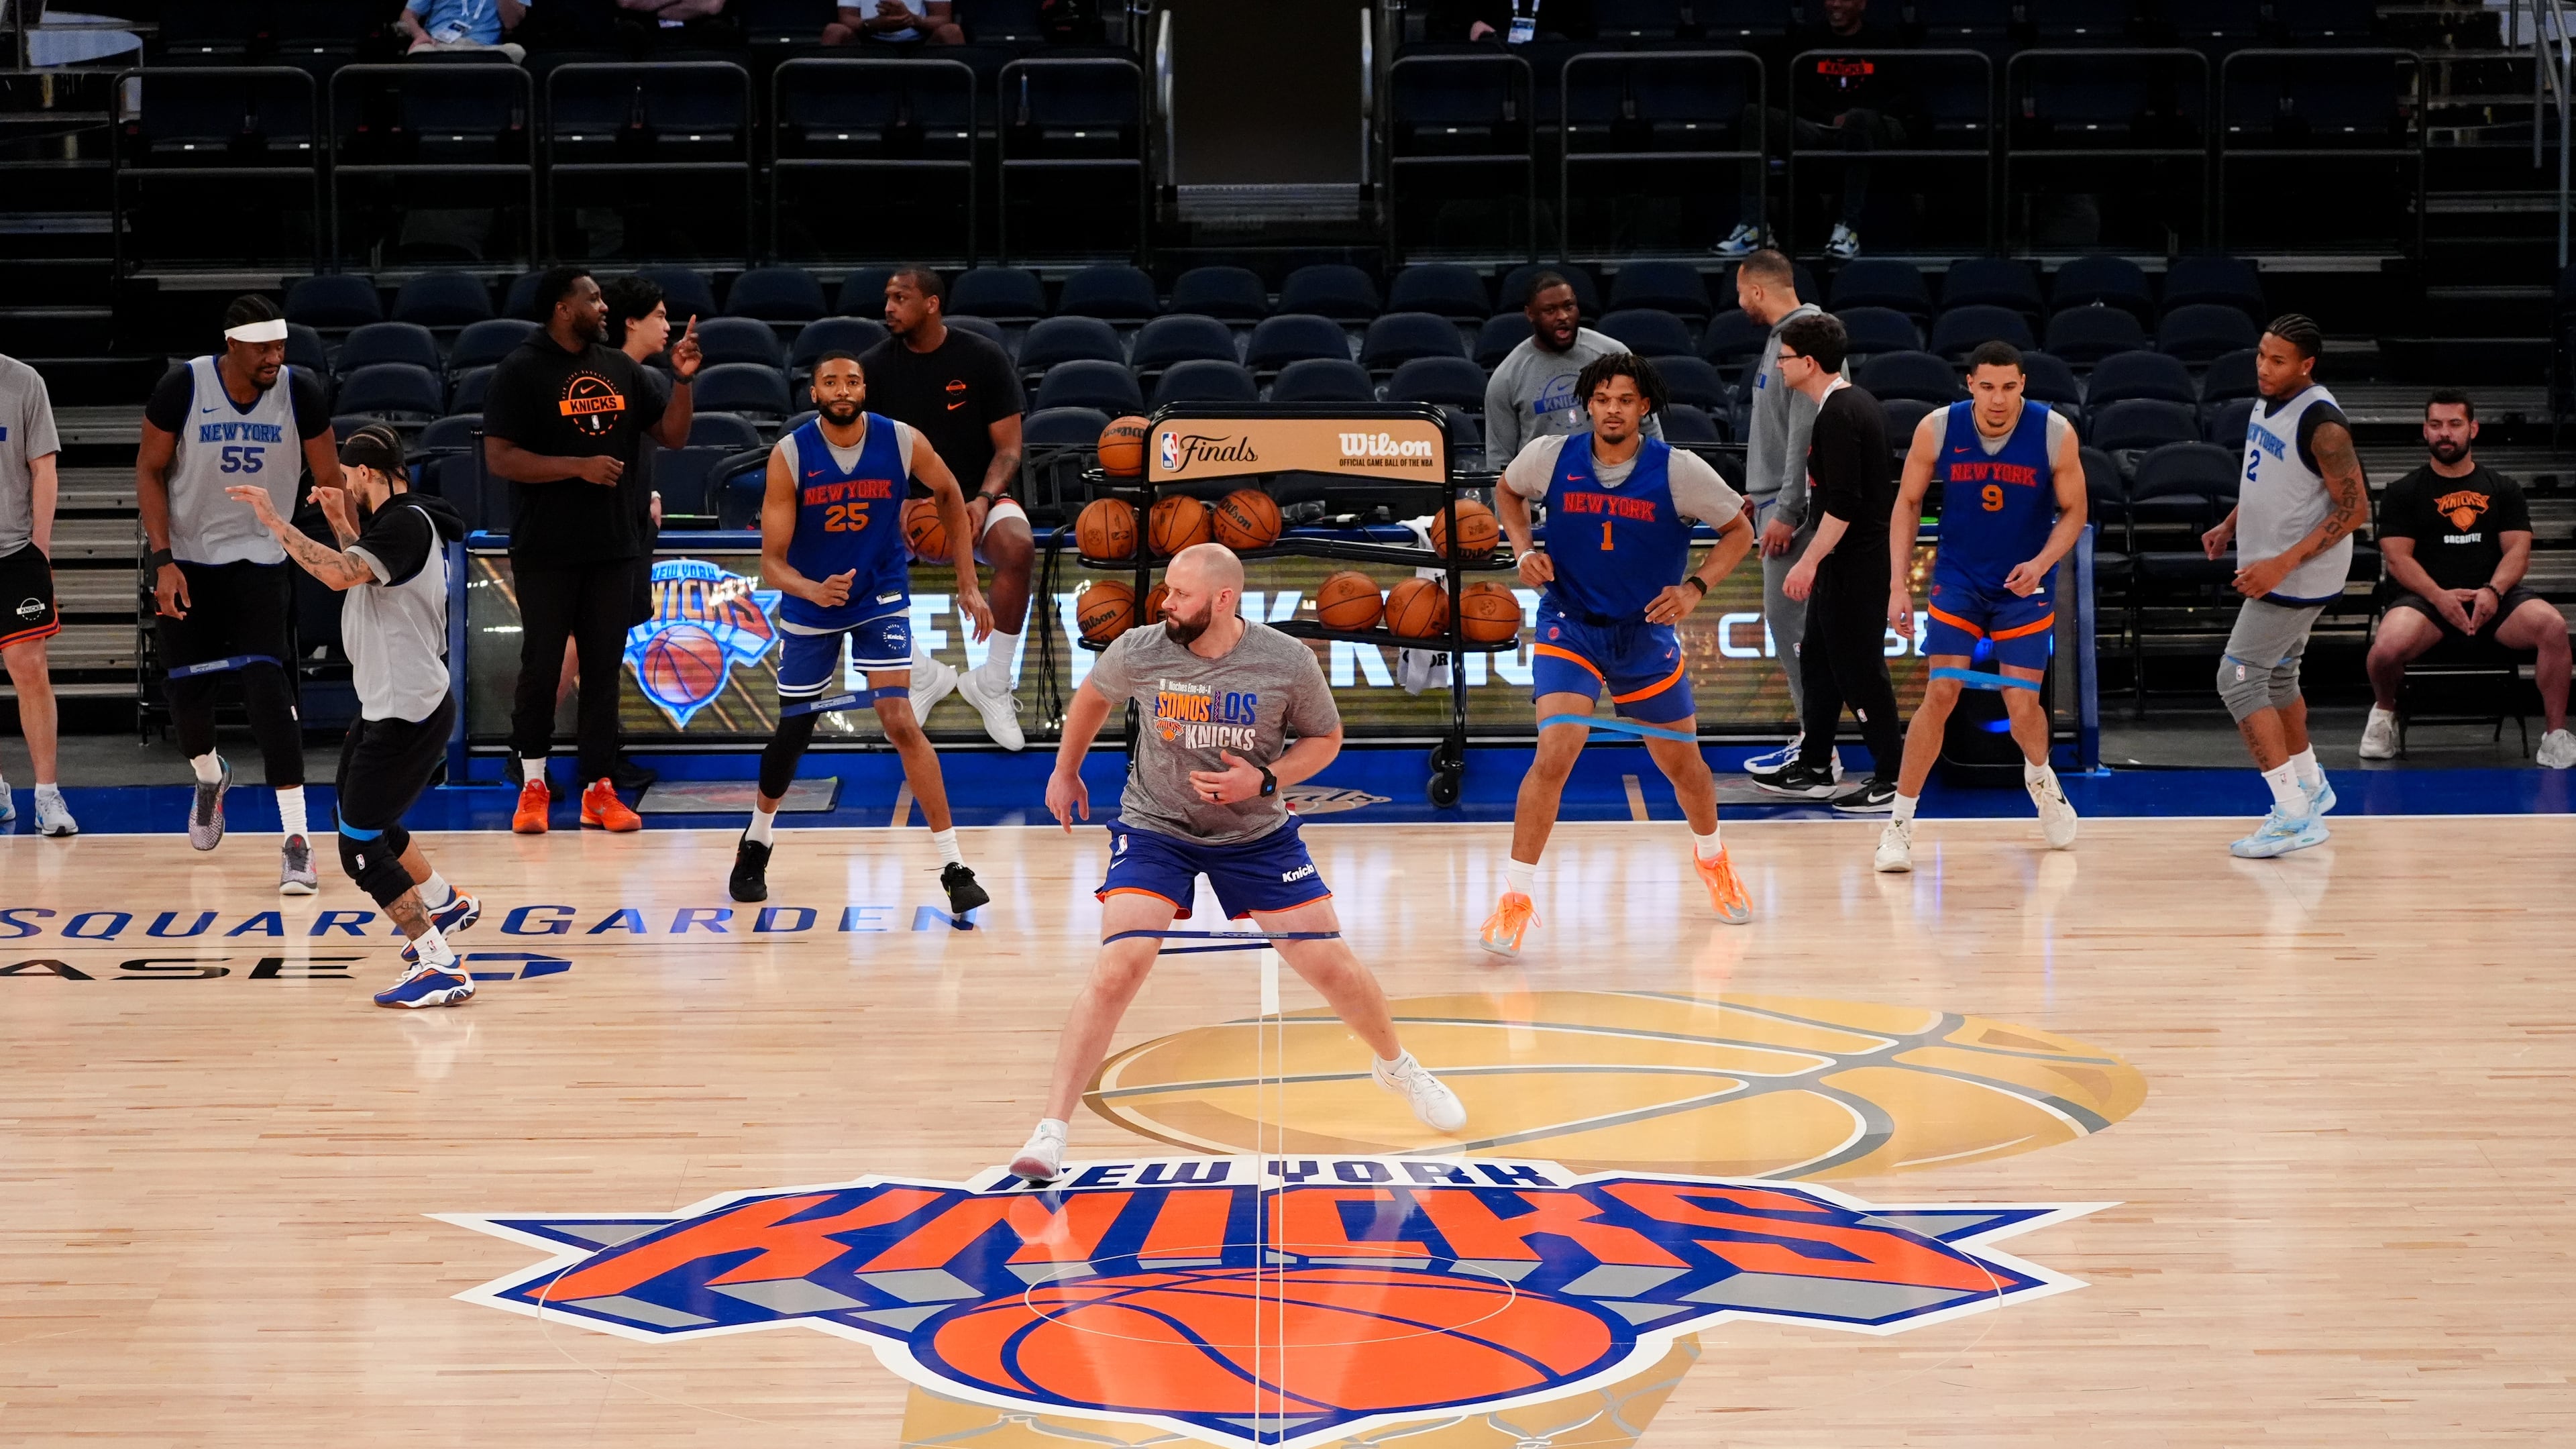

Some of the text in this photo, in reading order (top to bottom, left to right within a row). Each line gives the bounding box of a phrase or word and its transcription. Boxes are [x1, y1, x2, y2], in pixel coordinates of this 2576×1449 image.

[570, 397, 617, 413] KNICKS
[199, 423, 282, 443] NEW YORK
[1339, 433, 1432, 457] Wilson
[220, 446, 265, 473] 55
[1171, 435, 1258, 473] Finals
[1339, 458, 1433, 467] OFFICIAL GAME BALL OF THE NBA
[2247, 449, 2261, 482] 2
[1950, 462, 2037, 488] NEW YORK
[804, 479, 892, 505] NEW YORK
[1982, 484, 2004, 511] 9
[2440, 493, 2485, 511] KNICKS
[824, 502, 869, 532] 25
[1220, 498, 1252, 531] Wilson
[1563, 492, 1656, 522] NEW YORK
[1601, 521, 1614, 550] 1
[21, 604, 41, 613] KNICKS
[1080, 610, 1117, 632] Wilson
[1169, 681, 1187, 692] Noches
[1158, 691, 1257, 726] SOMOS LOS
[1185, 724, 1256, 751] KNICKS
[1282, 864, 1315, 882] Knicks
[500, 905, 975, 935] GARDEN
[1268, 1161, 1560, 1187] YORK
[530, 1183, 2019, 1301] KNICKS
